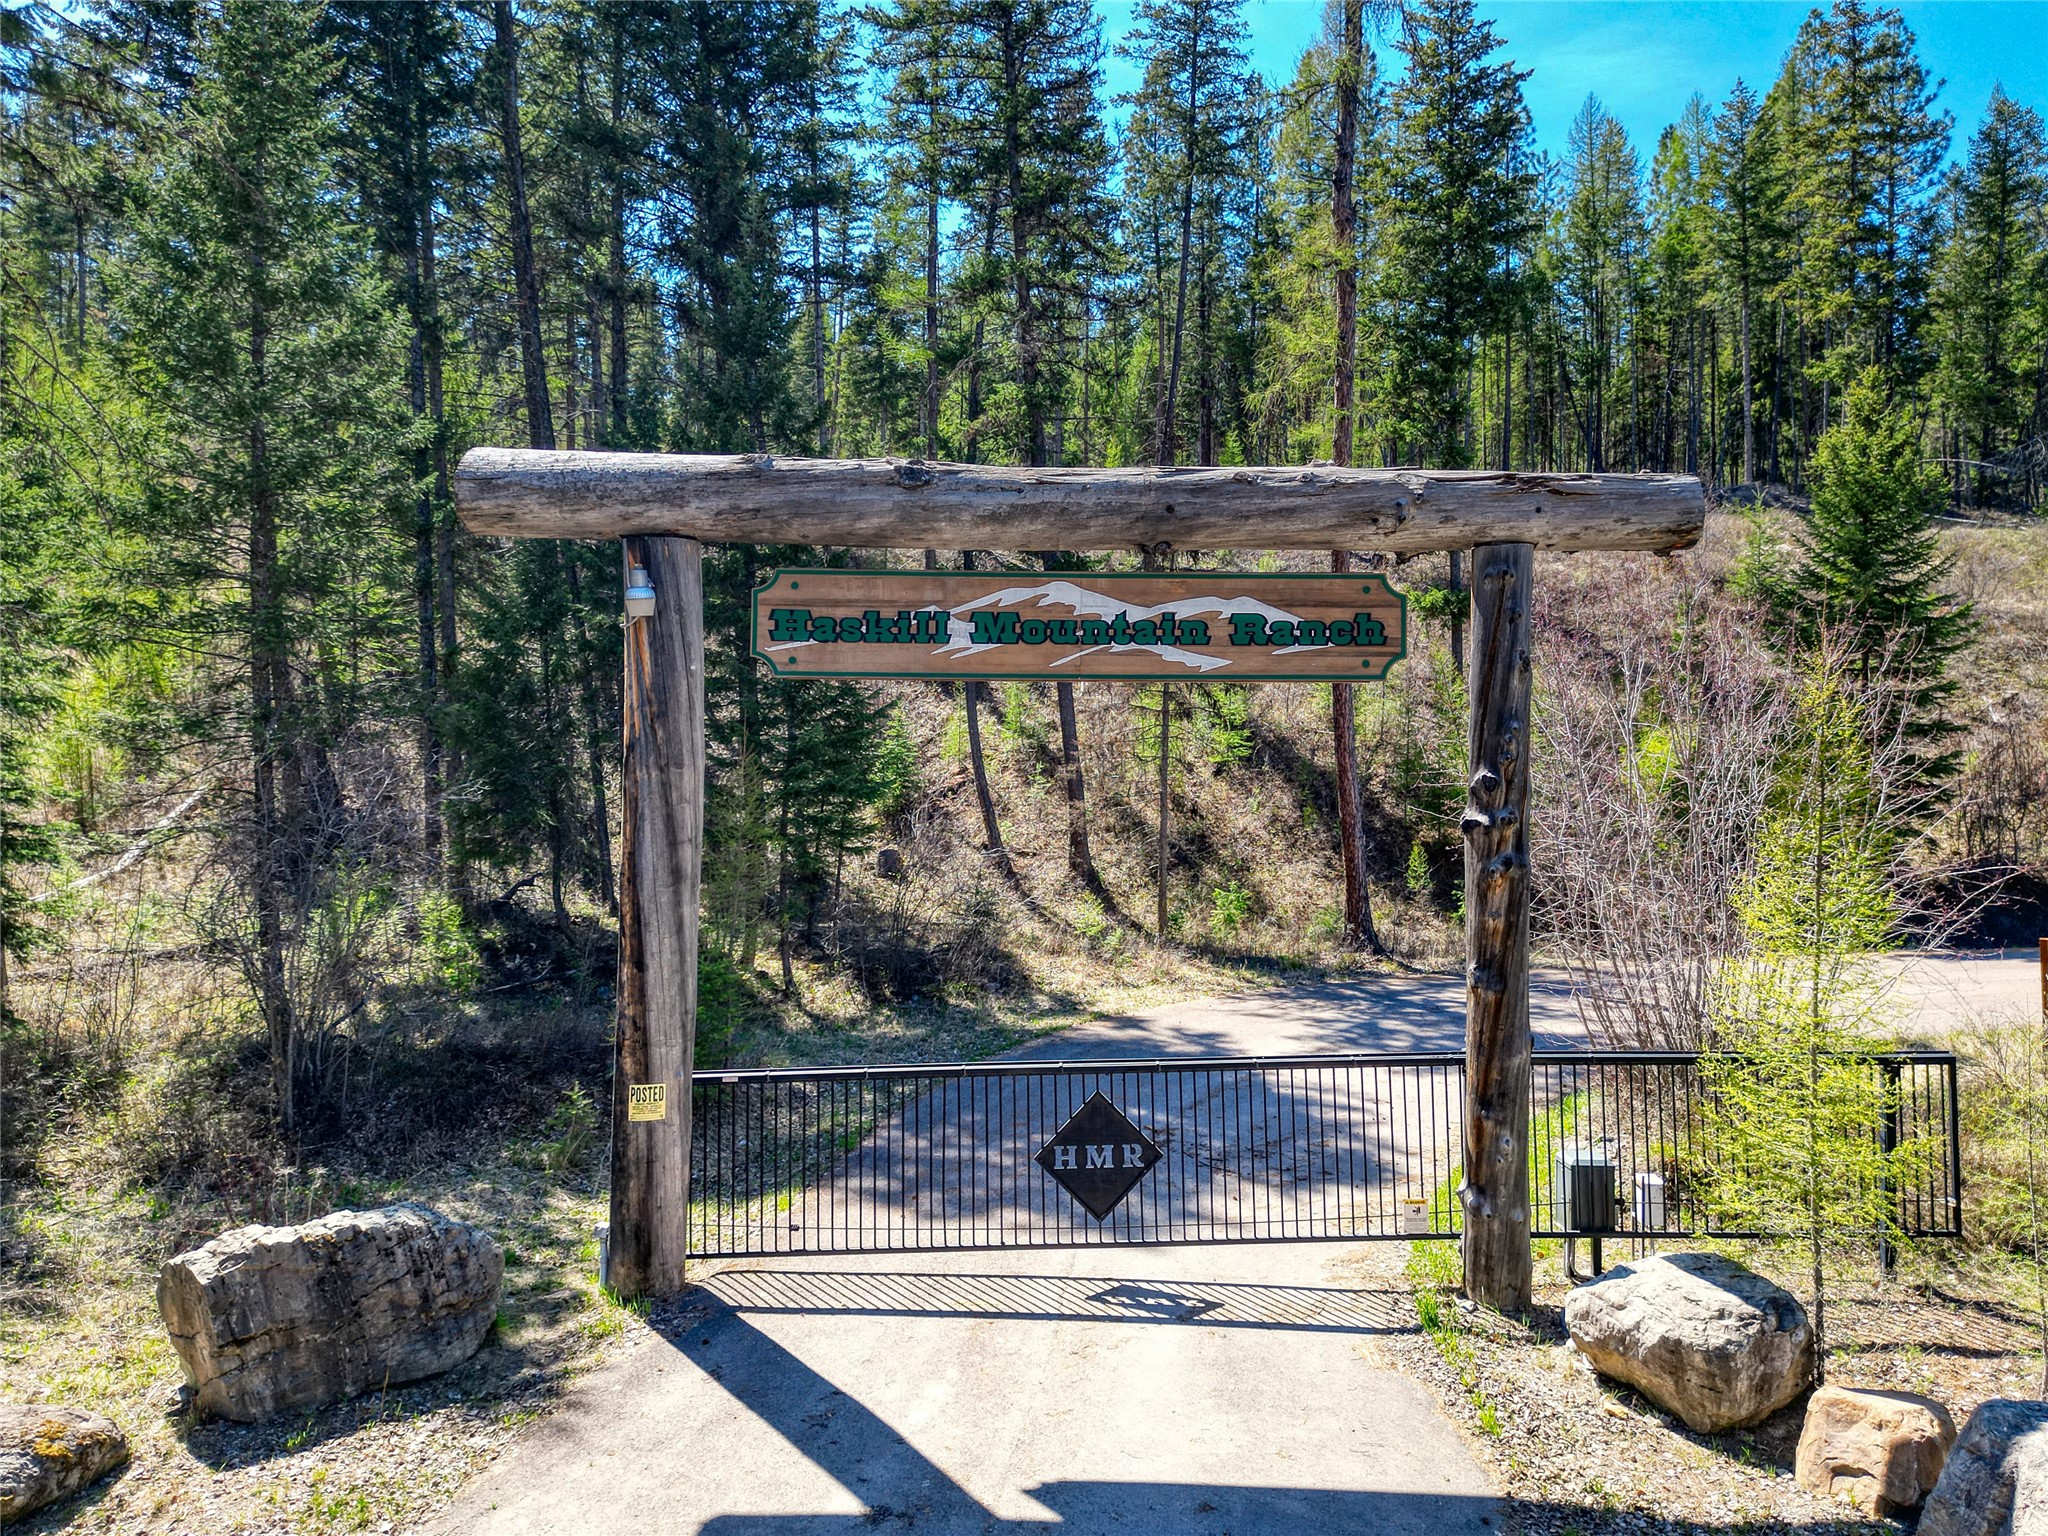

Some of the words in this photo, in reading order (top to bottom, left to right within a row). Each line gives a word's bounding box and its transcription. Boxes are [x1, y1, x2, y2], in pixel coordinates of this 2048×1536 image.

[768, 608, 952, 644] Haskill
[969, 608, 1212, 646] Mountain
[1228, 612, 1389, 647] Ranch
[630, 1086, 664, 1103] POSTED
[1053, 1143, 1145, 1170] HMR
